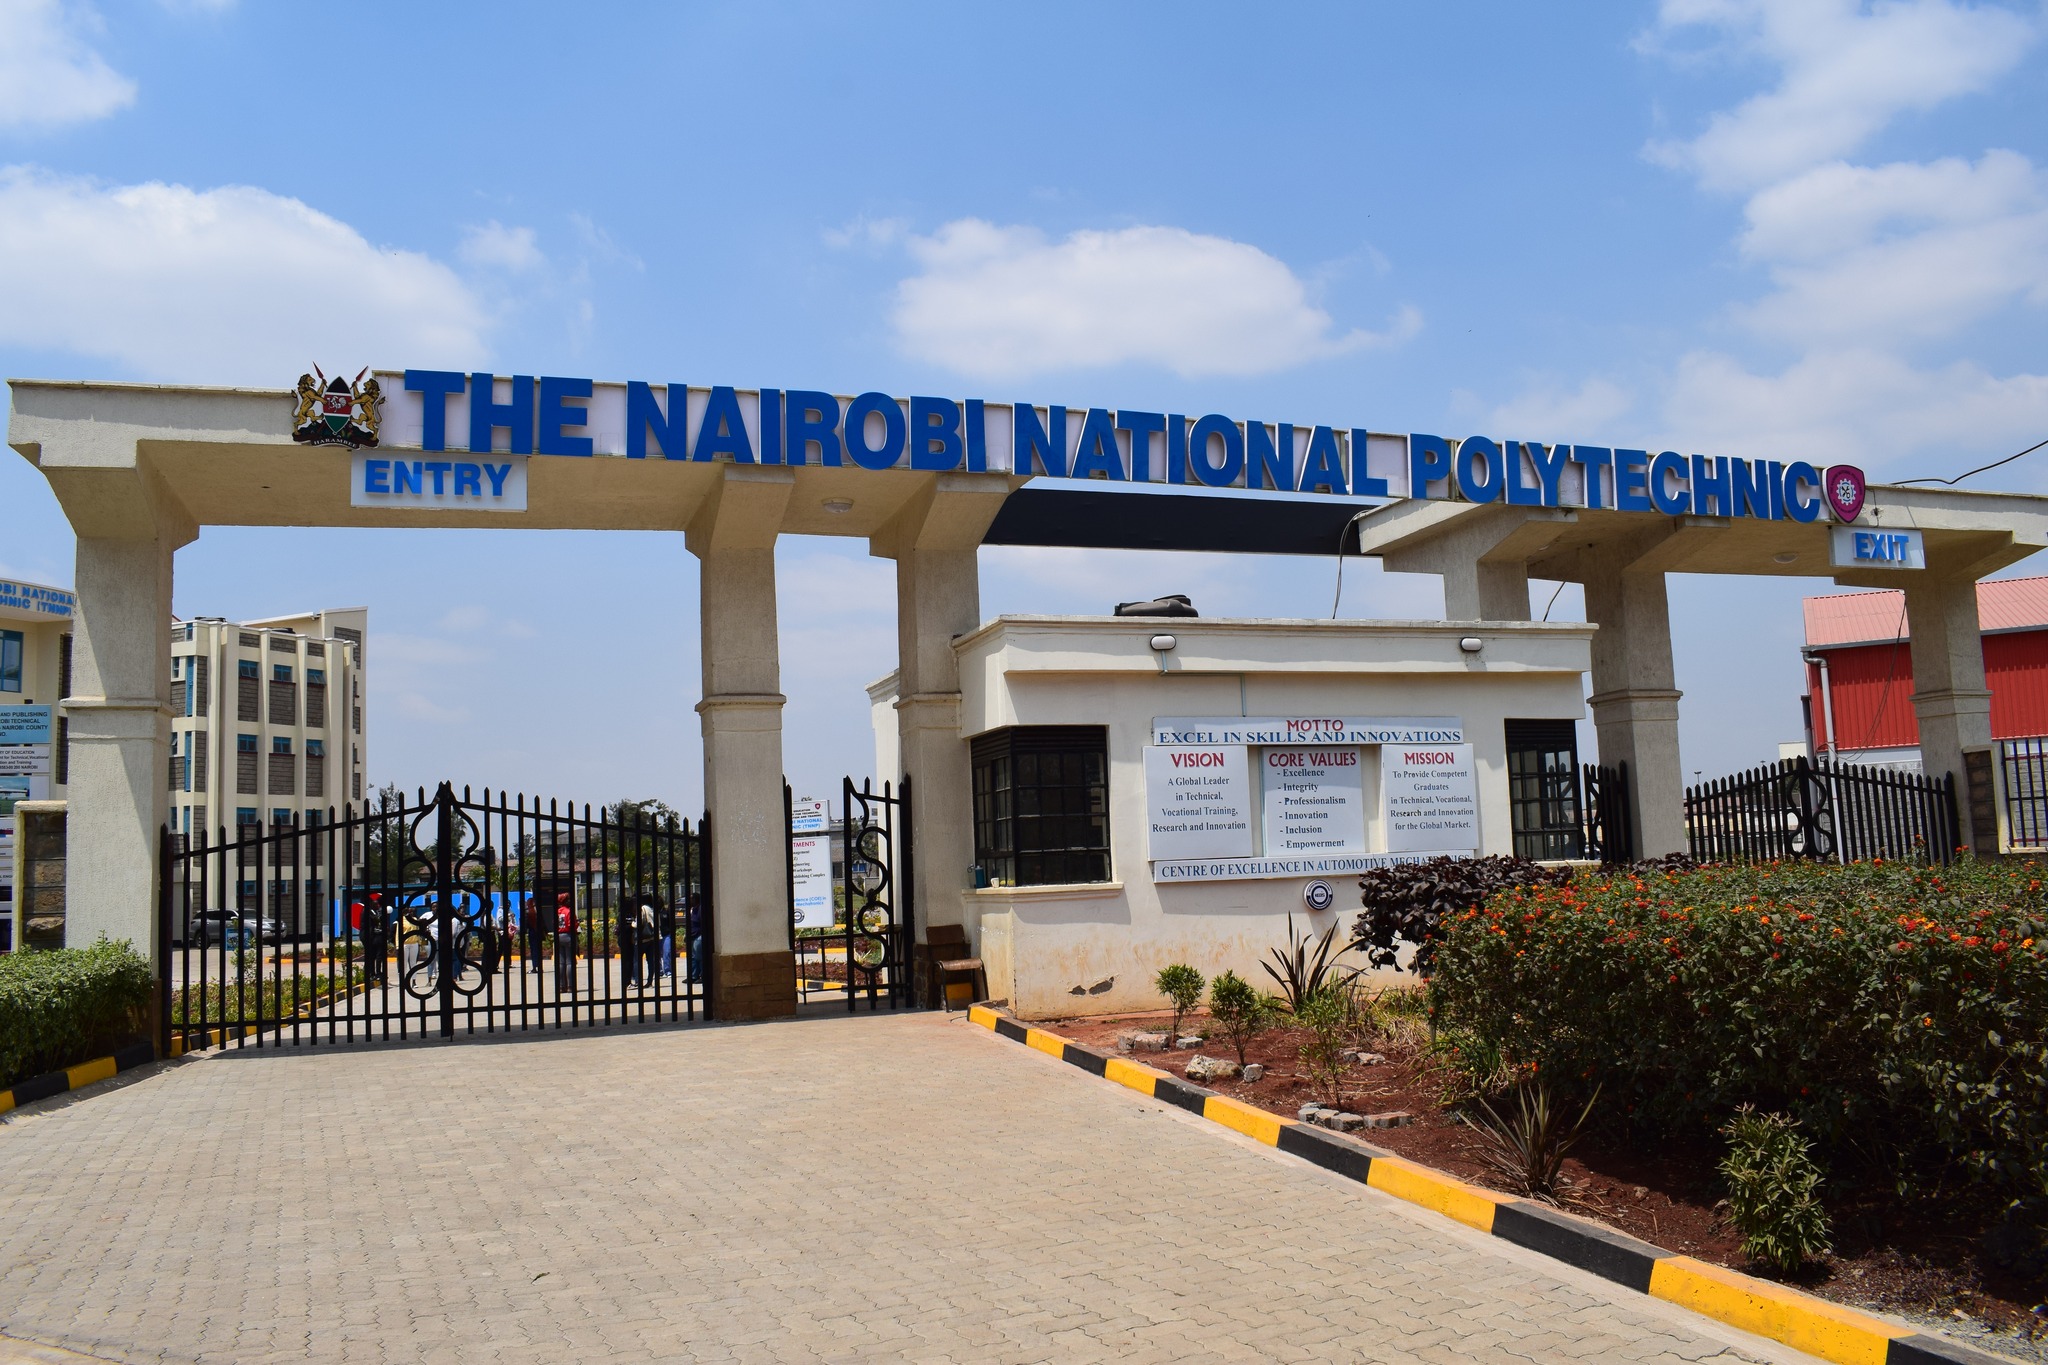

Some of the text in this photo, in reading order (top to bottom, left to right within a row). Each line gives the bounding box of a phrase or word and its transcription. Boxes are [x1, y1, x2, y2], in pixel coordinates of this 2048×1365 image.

[313, 438, 357, 448] HARAMBEE
[405, 369, 593, 457] THE
[626, 380, 987, 473] NAIROBI
[1012, 403, 1388, 495] NATIONAL
[1407, 433, 1820, 524] POLYTECHNIC
[365, 460, 512, 496] ENTRY
[1853, 532, 1909, 561] EXIT
[1286, 719, 1344, 731] MOTTO
[1160, 731, 1461, 743] EXCEL IN SKILLS AND INNOVATIONS
[1170, 752, 1224, 768] VISION
[1269, 752, 1356, 767] CORE VALUES
[1404, 752, 1454, 765] MISSION
[1283, 769, 1325, 777] Excellence
[1392, 770, 1467, 779] To Provide Competent
[1168, 776, 1229, 786] A Global Leader
[1283, 782, 1318, 793] Integrity
[1413, 783, 1449, 791] Graduates
[1176, 791, 1223, 801] in Technical,
[1284, 796, 1346, 805] Professionalism
[1390, 796, 1398, 804] in
[1162, 806, 1238, 816] Vocational Training,
[1285, 810, 1328, 820] Innovation
[1390, 808, 1474, 817] Research and Innovation
[1152, 821, 1246, 832] Research and Innovation
[1285, 825, 1322, 834] Inclusion
[1395, 821, 1471, 830] for the Global Market.
[1286, 839, 1345, 850] Empowerment
[1162, 865, 1207, 877] CENTRE
[1210, 864, 1225, 875] OF
[1228, 861, 1300, 875] EXCELLENCE
[1303, 861, 1314, 871] IN
[1316, 857, 1387, 871] AUTOMOTIVE
